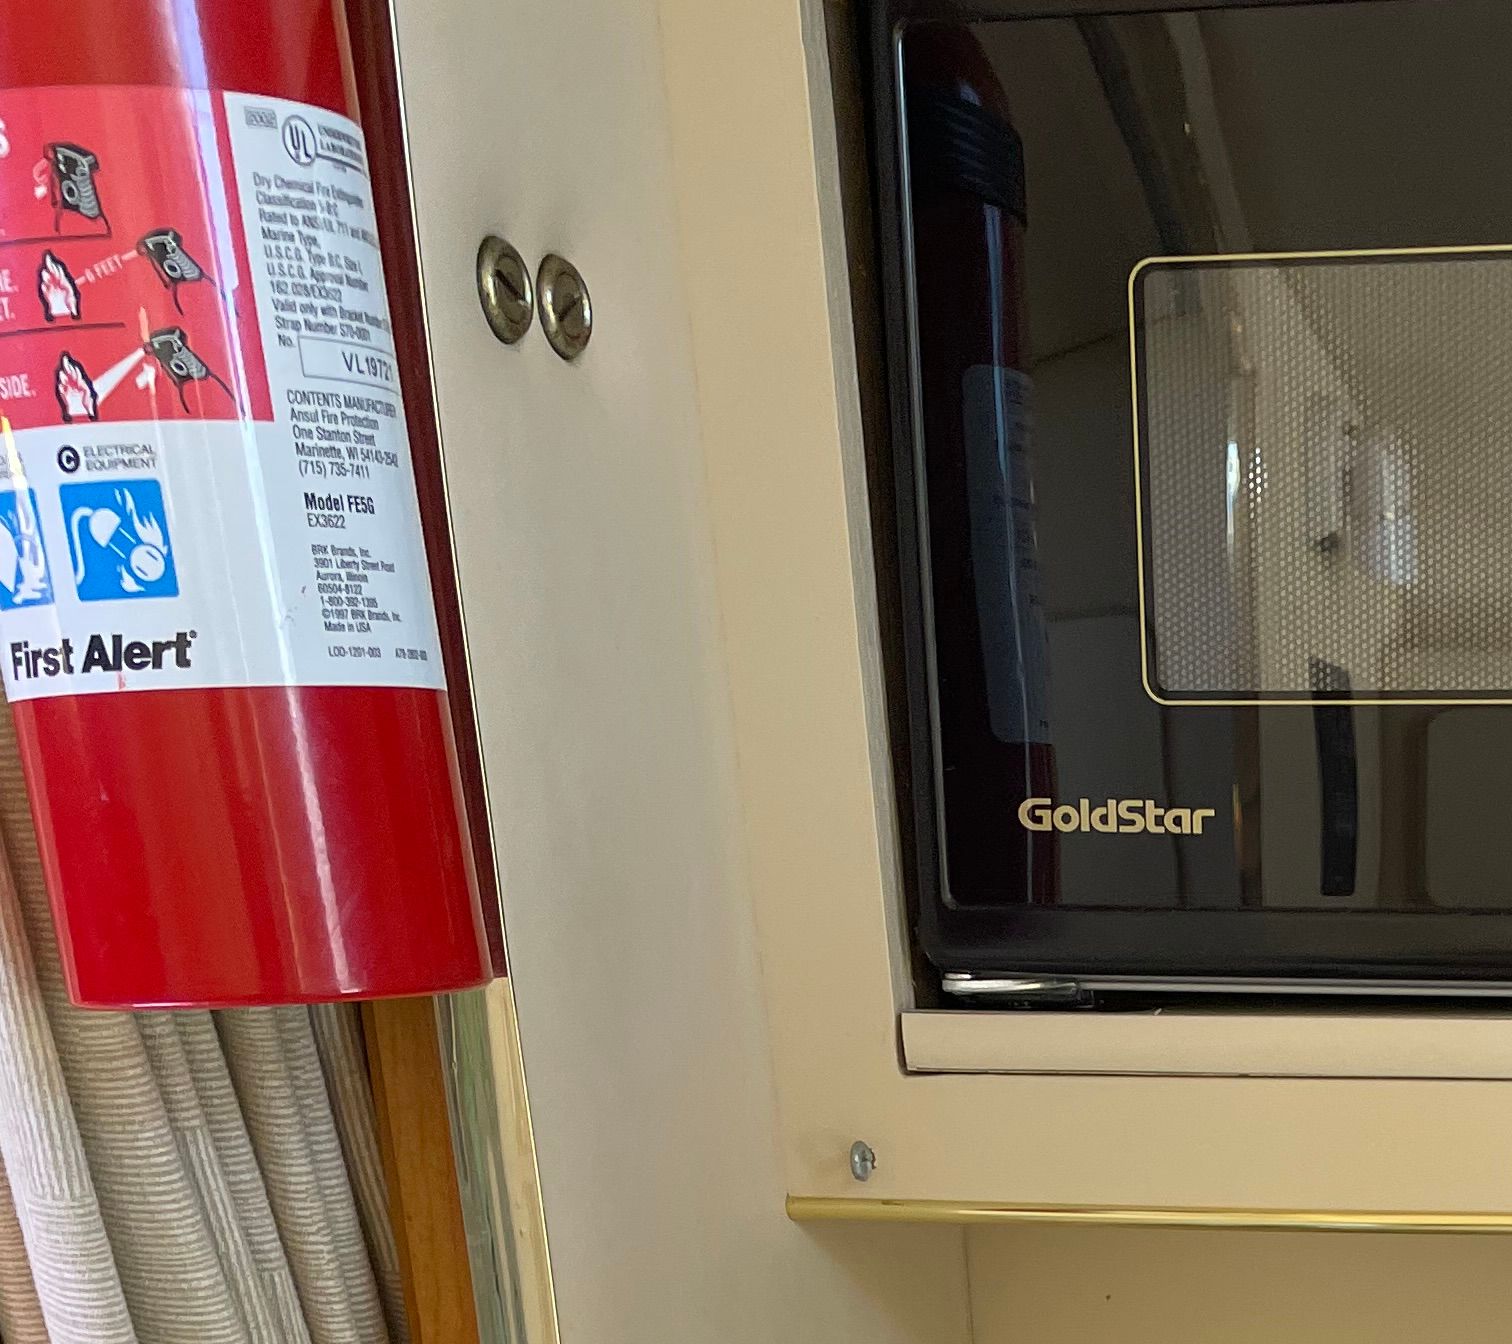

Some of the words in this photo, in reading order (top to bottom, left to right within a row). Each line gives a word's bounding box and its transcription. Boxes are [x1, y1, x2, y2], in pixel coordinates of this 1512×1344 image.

[286, 120, 314, 162] UL
[253, 171, 272, 190] Dry
[287, 389, 342, 409] CONTENTS
[343, 395, 397, 419] MANUFACTURER
[290, 407, 319, 424] Ansul
[321, 409, 339, 427] Fire
[341, 413, 379, 432] Protection
[292, 424, 313, 441] One
[316, 426, 351, 444] Stanton
[353, 431, 376, 448] Street
[82, 444, 157, 456] ELECTRICAL
[295, 441, 345, 462] Marinette,
[347, 446, 360, 462] WI
[85, 457, 157, 471] EQUIPMENT
[299, 459, 328, 480] (715)
[330, 461, 370, 480] 735-7411
[303, 491, 345, 513] Model
[347, 495, 376, 515] FE5G
[307, 513, 347, 530] EX3622
[311, 543, 329, 556] BRK
[314, 557, 334, 570] 3901
[335, 558, 360, 573] Liberty
[324, 620, 346, 633] Made
[356, 622, 371, 634] USA
[10, 638, 75, 681] First
[1018, 798, 1215, 835] GoldStar
